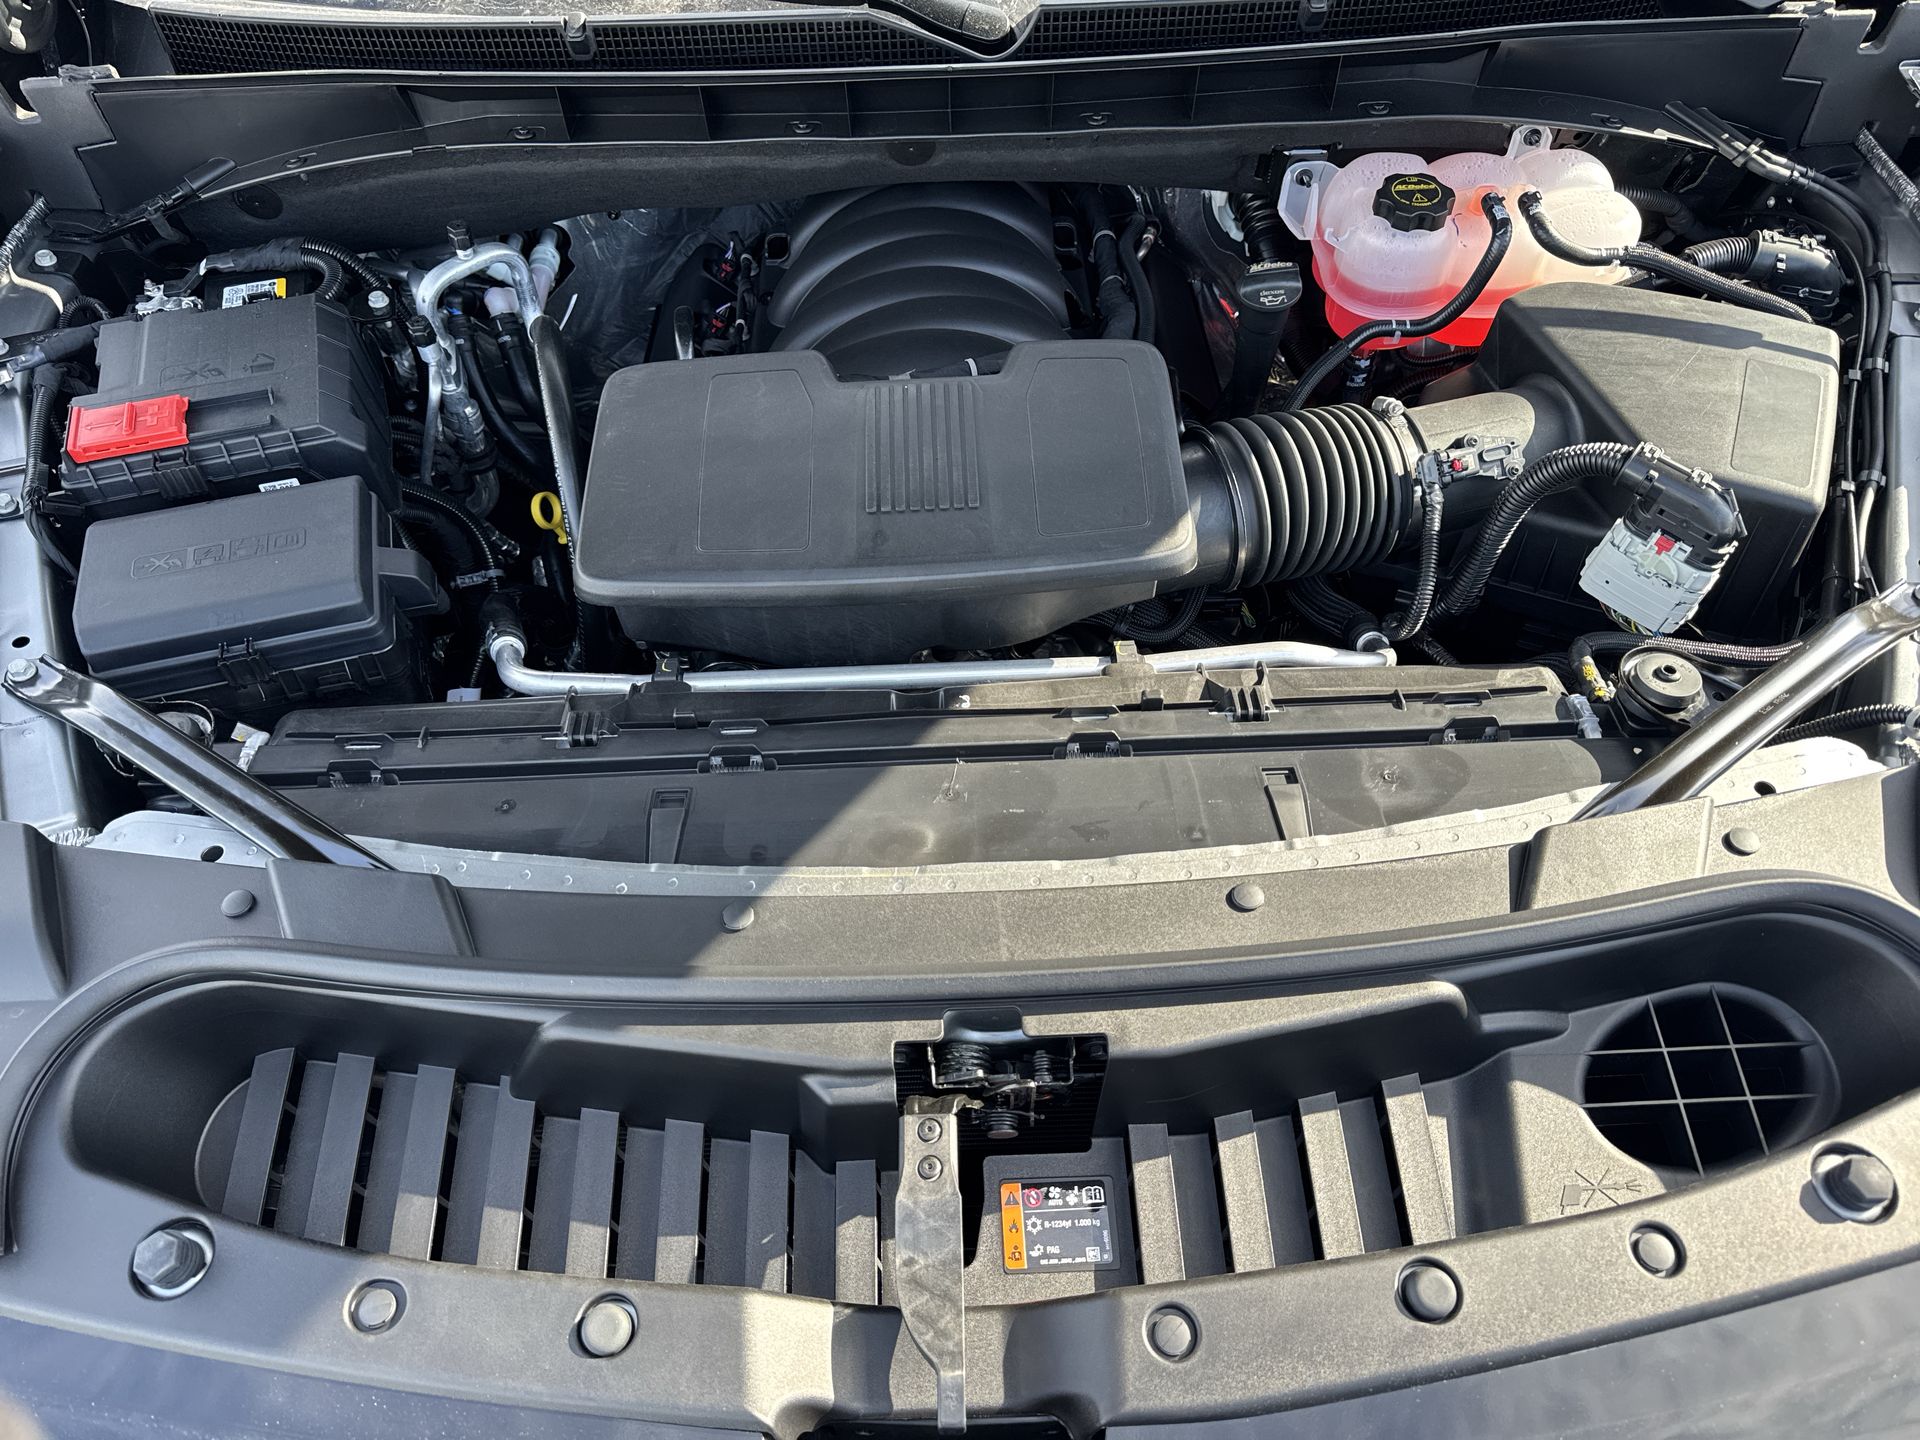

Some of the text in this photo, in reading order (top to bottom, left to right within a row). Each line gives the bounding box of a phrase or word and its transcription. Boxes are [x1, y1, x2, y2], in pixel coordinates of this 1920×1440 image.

[1394, 183, 1437, 191] ACDelco
[1249, 261, 1293, 273] ACDelco
[1074, 1218, 1092, 1227] 1.000
[1092, 1218, 1101, 1227] kg
[1046, 1245, 1060, 1254] PAG
